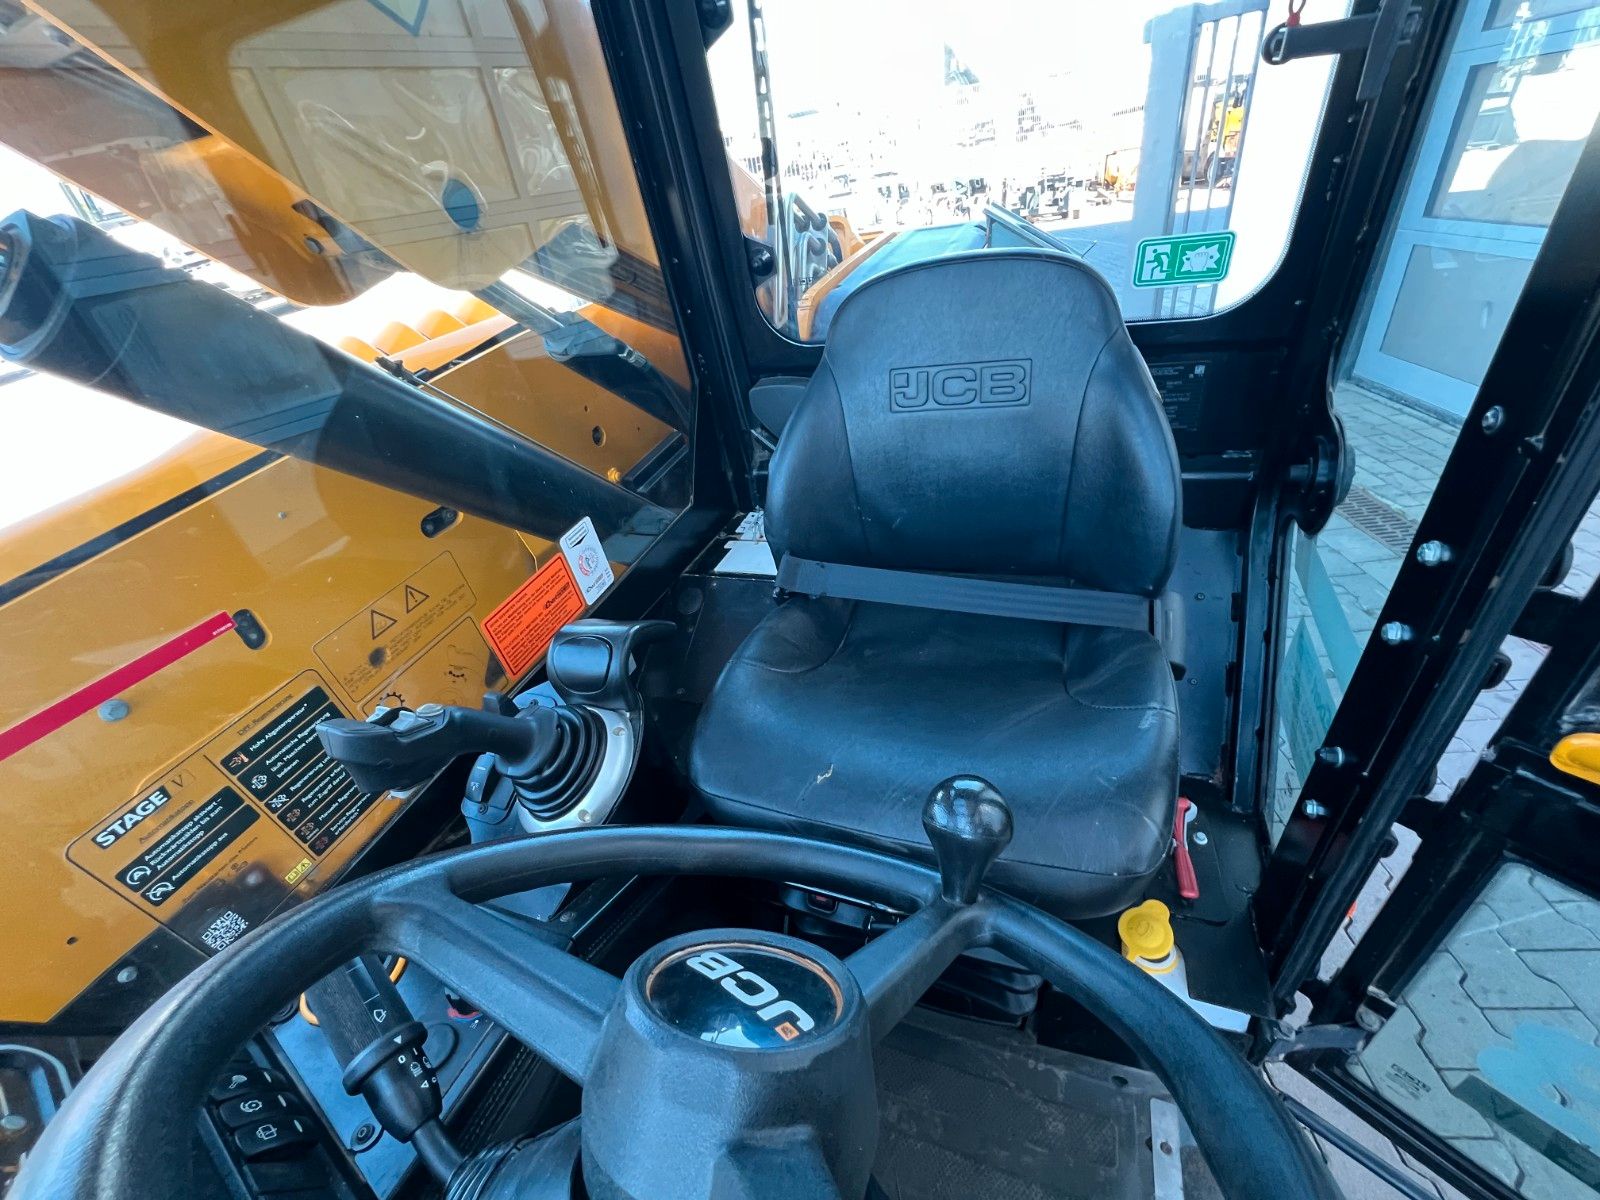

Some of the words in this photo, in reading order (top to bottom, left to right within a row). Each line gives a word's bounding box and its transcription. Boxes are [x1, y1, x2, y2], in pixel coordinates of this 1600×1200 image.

[893, 364, 1027, 408] JCB
[95, 790, 168, 847] STAGE
[171, 774, 185, 788] V
[143, 819, 194, 861] Automatikstopp
[155, 829, 205, 870] Automatikstopp
[686, 951, 815, 1033] JCB
